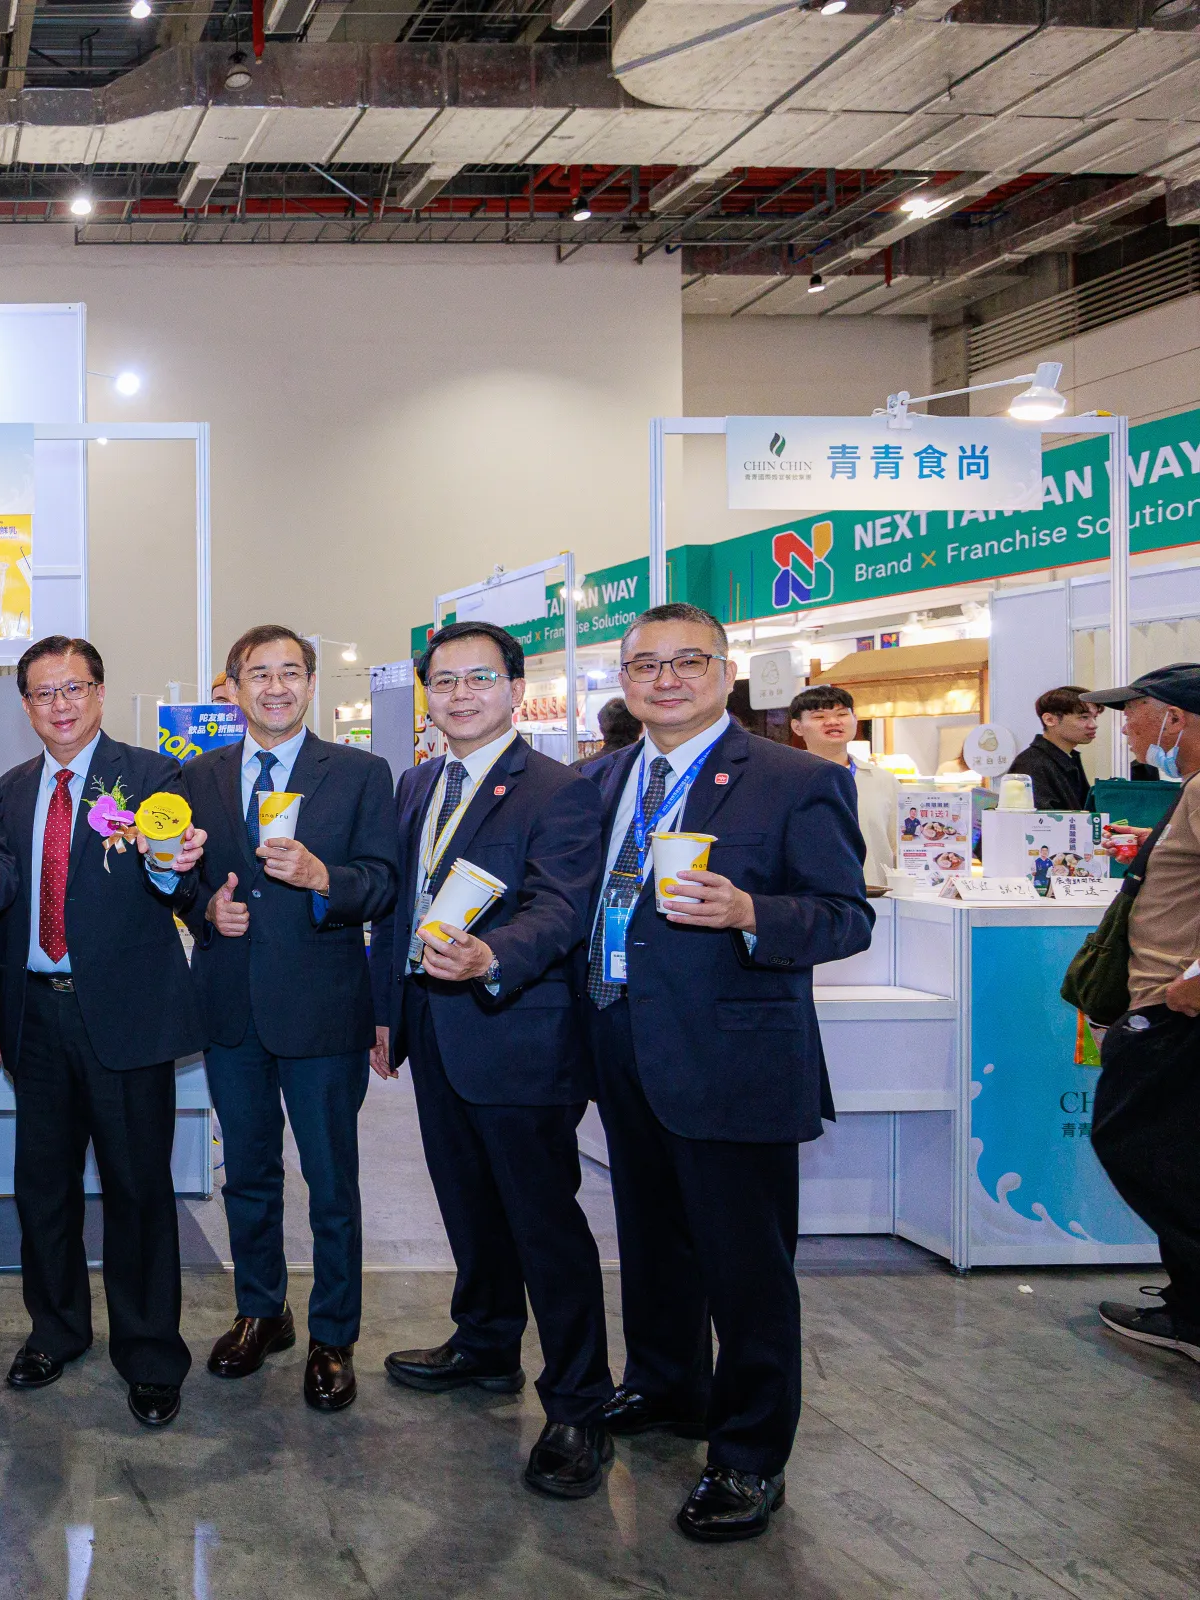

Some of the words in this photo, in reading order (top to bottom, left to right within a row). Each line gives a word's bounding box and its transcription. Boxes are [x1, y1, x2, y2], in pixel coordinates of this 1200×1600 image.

[743, 461, 776, 471] CHIN
[780, 461, 813, 471] CHIN
[827, 444, 989, 481] 青青食尚
[854, 510, 932, 550] NEXT
[855, 553, 912, 582] Brand
[947, 526, 1068, 564] Franchise
[1077, 497, 1200, 538] Soution
[602, 576, 638, 604] WAY
[544, 620, 593, 640] Franise
[592, 611, 636, 631] Solution
